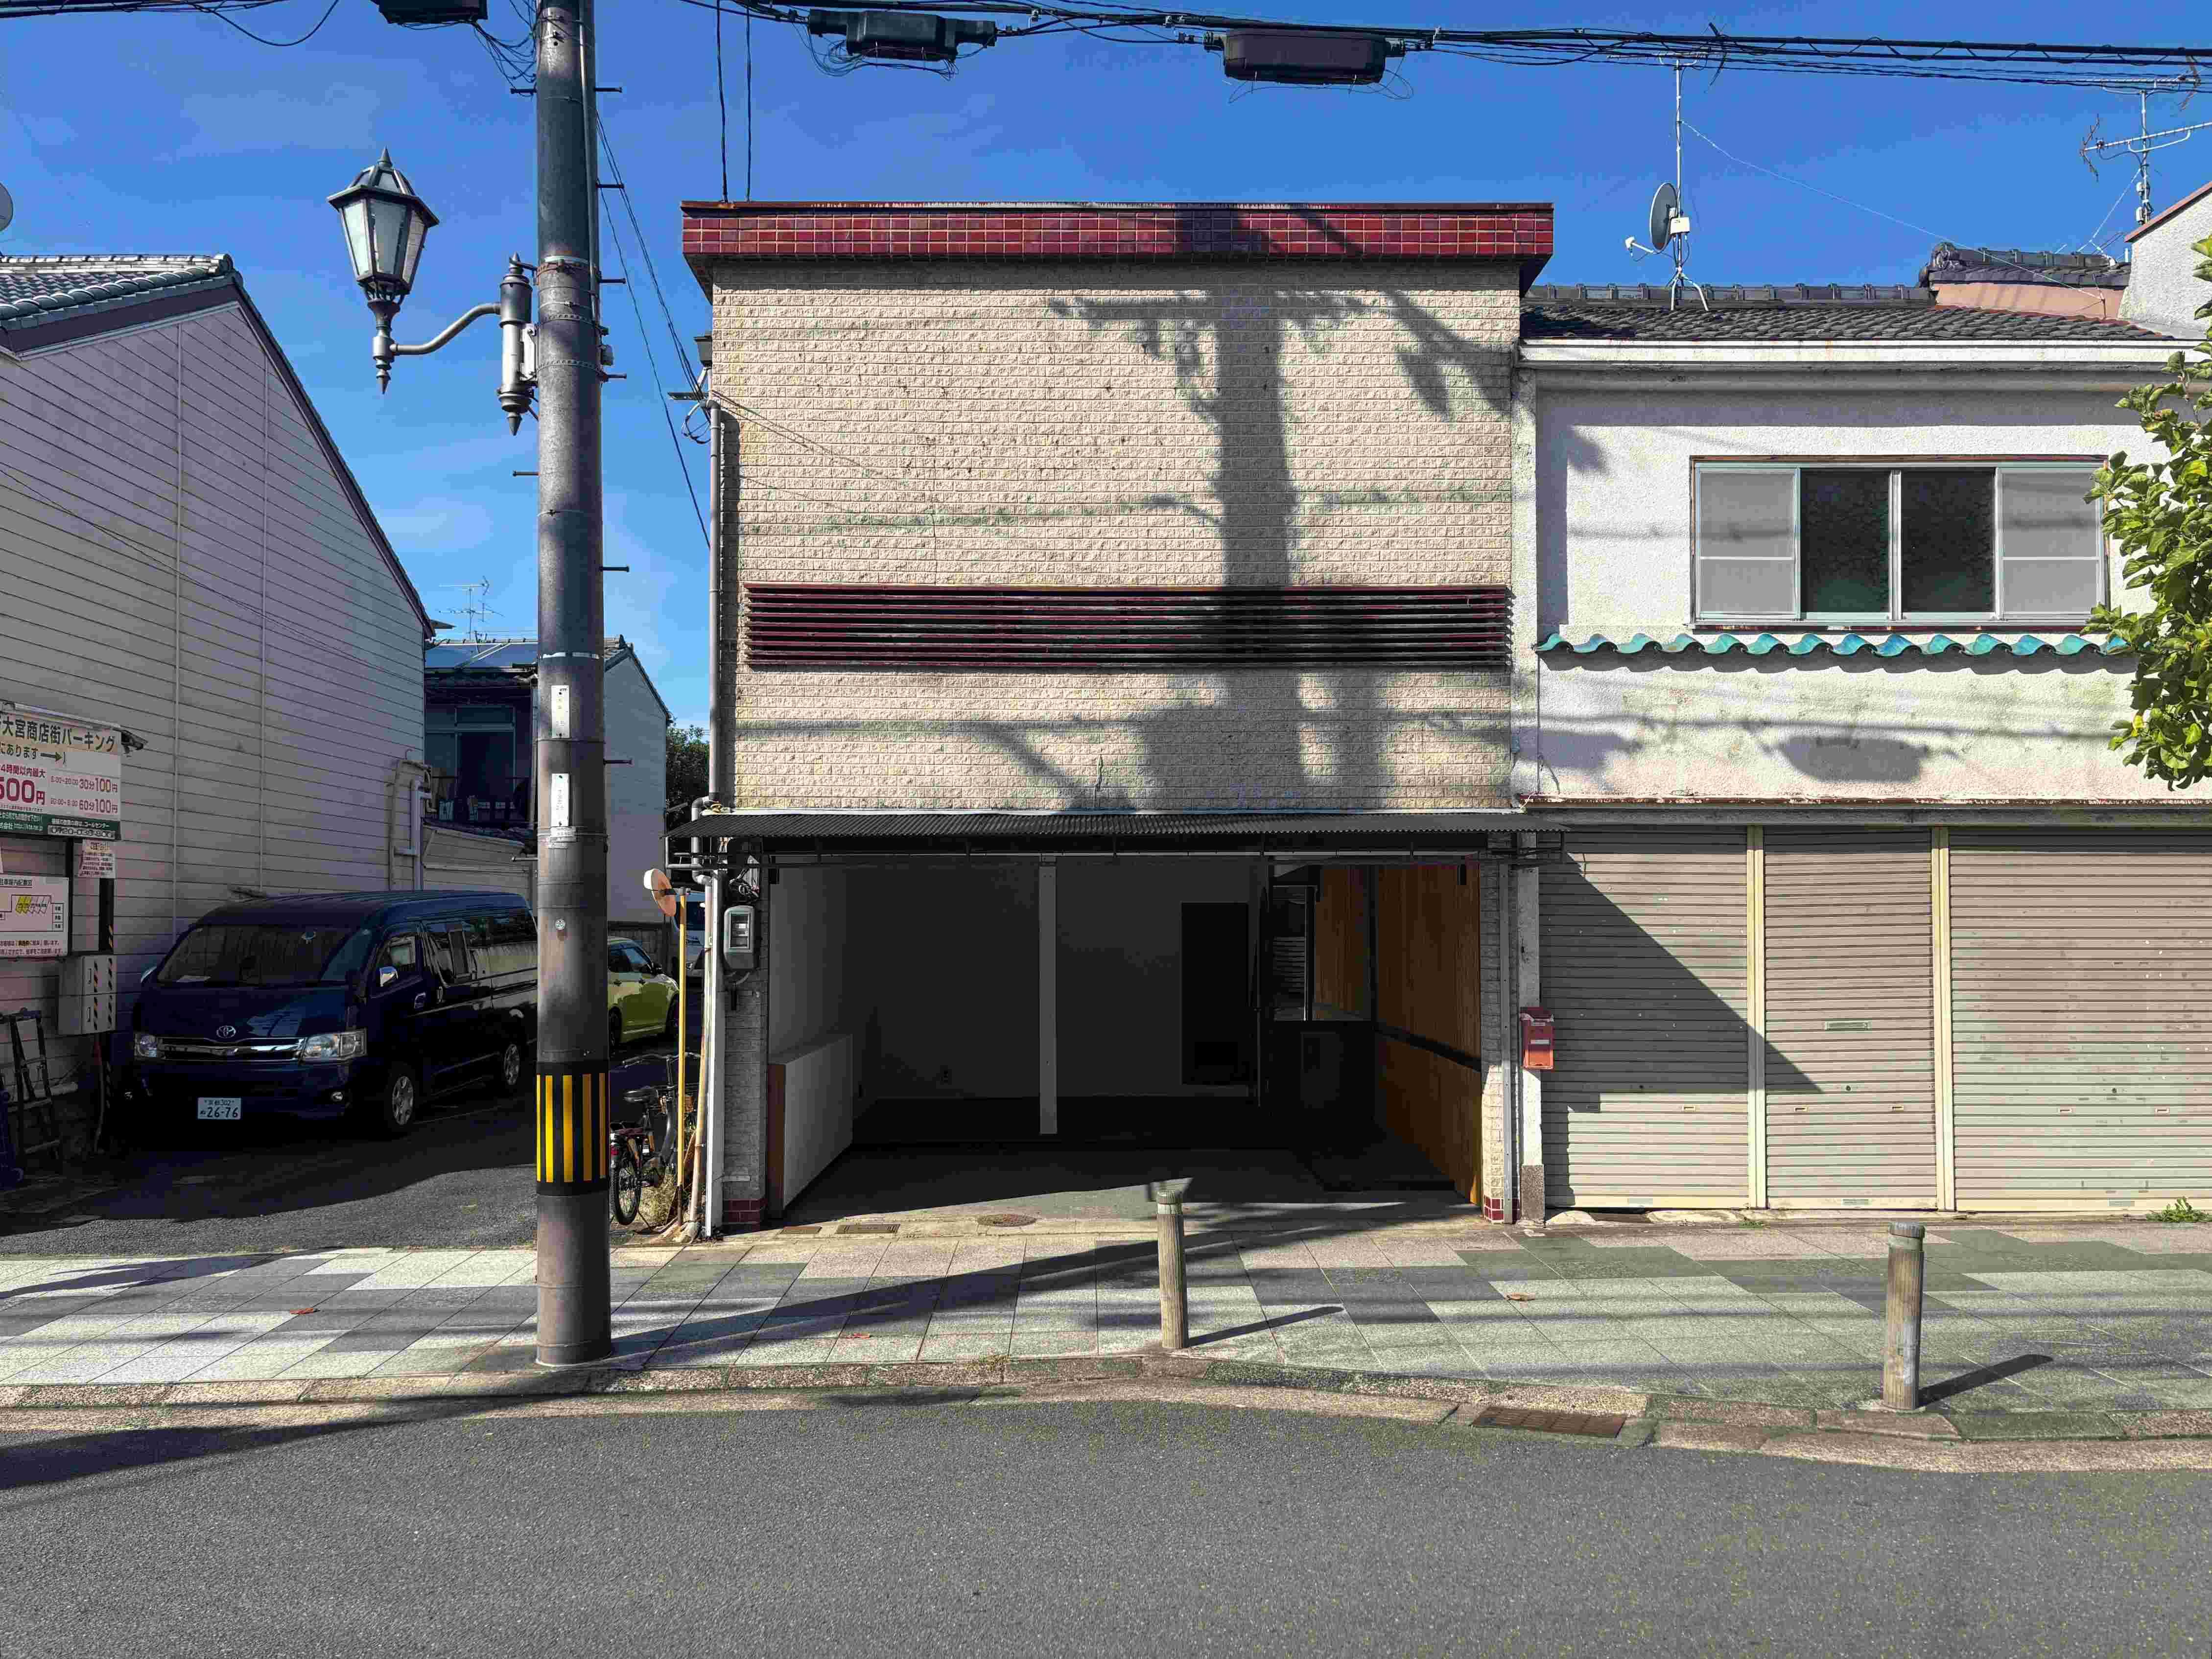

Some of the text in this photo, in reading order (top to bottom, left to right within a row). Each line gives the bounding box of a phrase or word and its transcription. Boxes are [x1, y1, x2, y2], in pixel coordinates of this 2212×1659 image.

[0, 716, 116, 752] 大宮商店街パーキング
[0, 764, 46, 778] 4時間以内最大
[207, 1107, 238, 1118] 26-76
